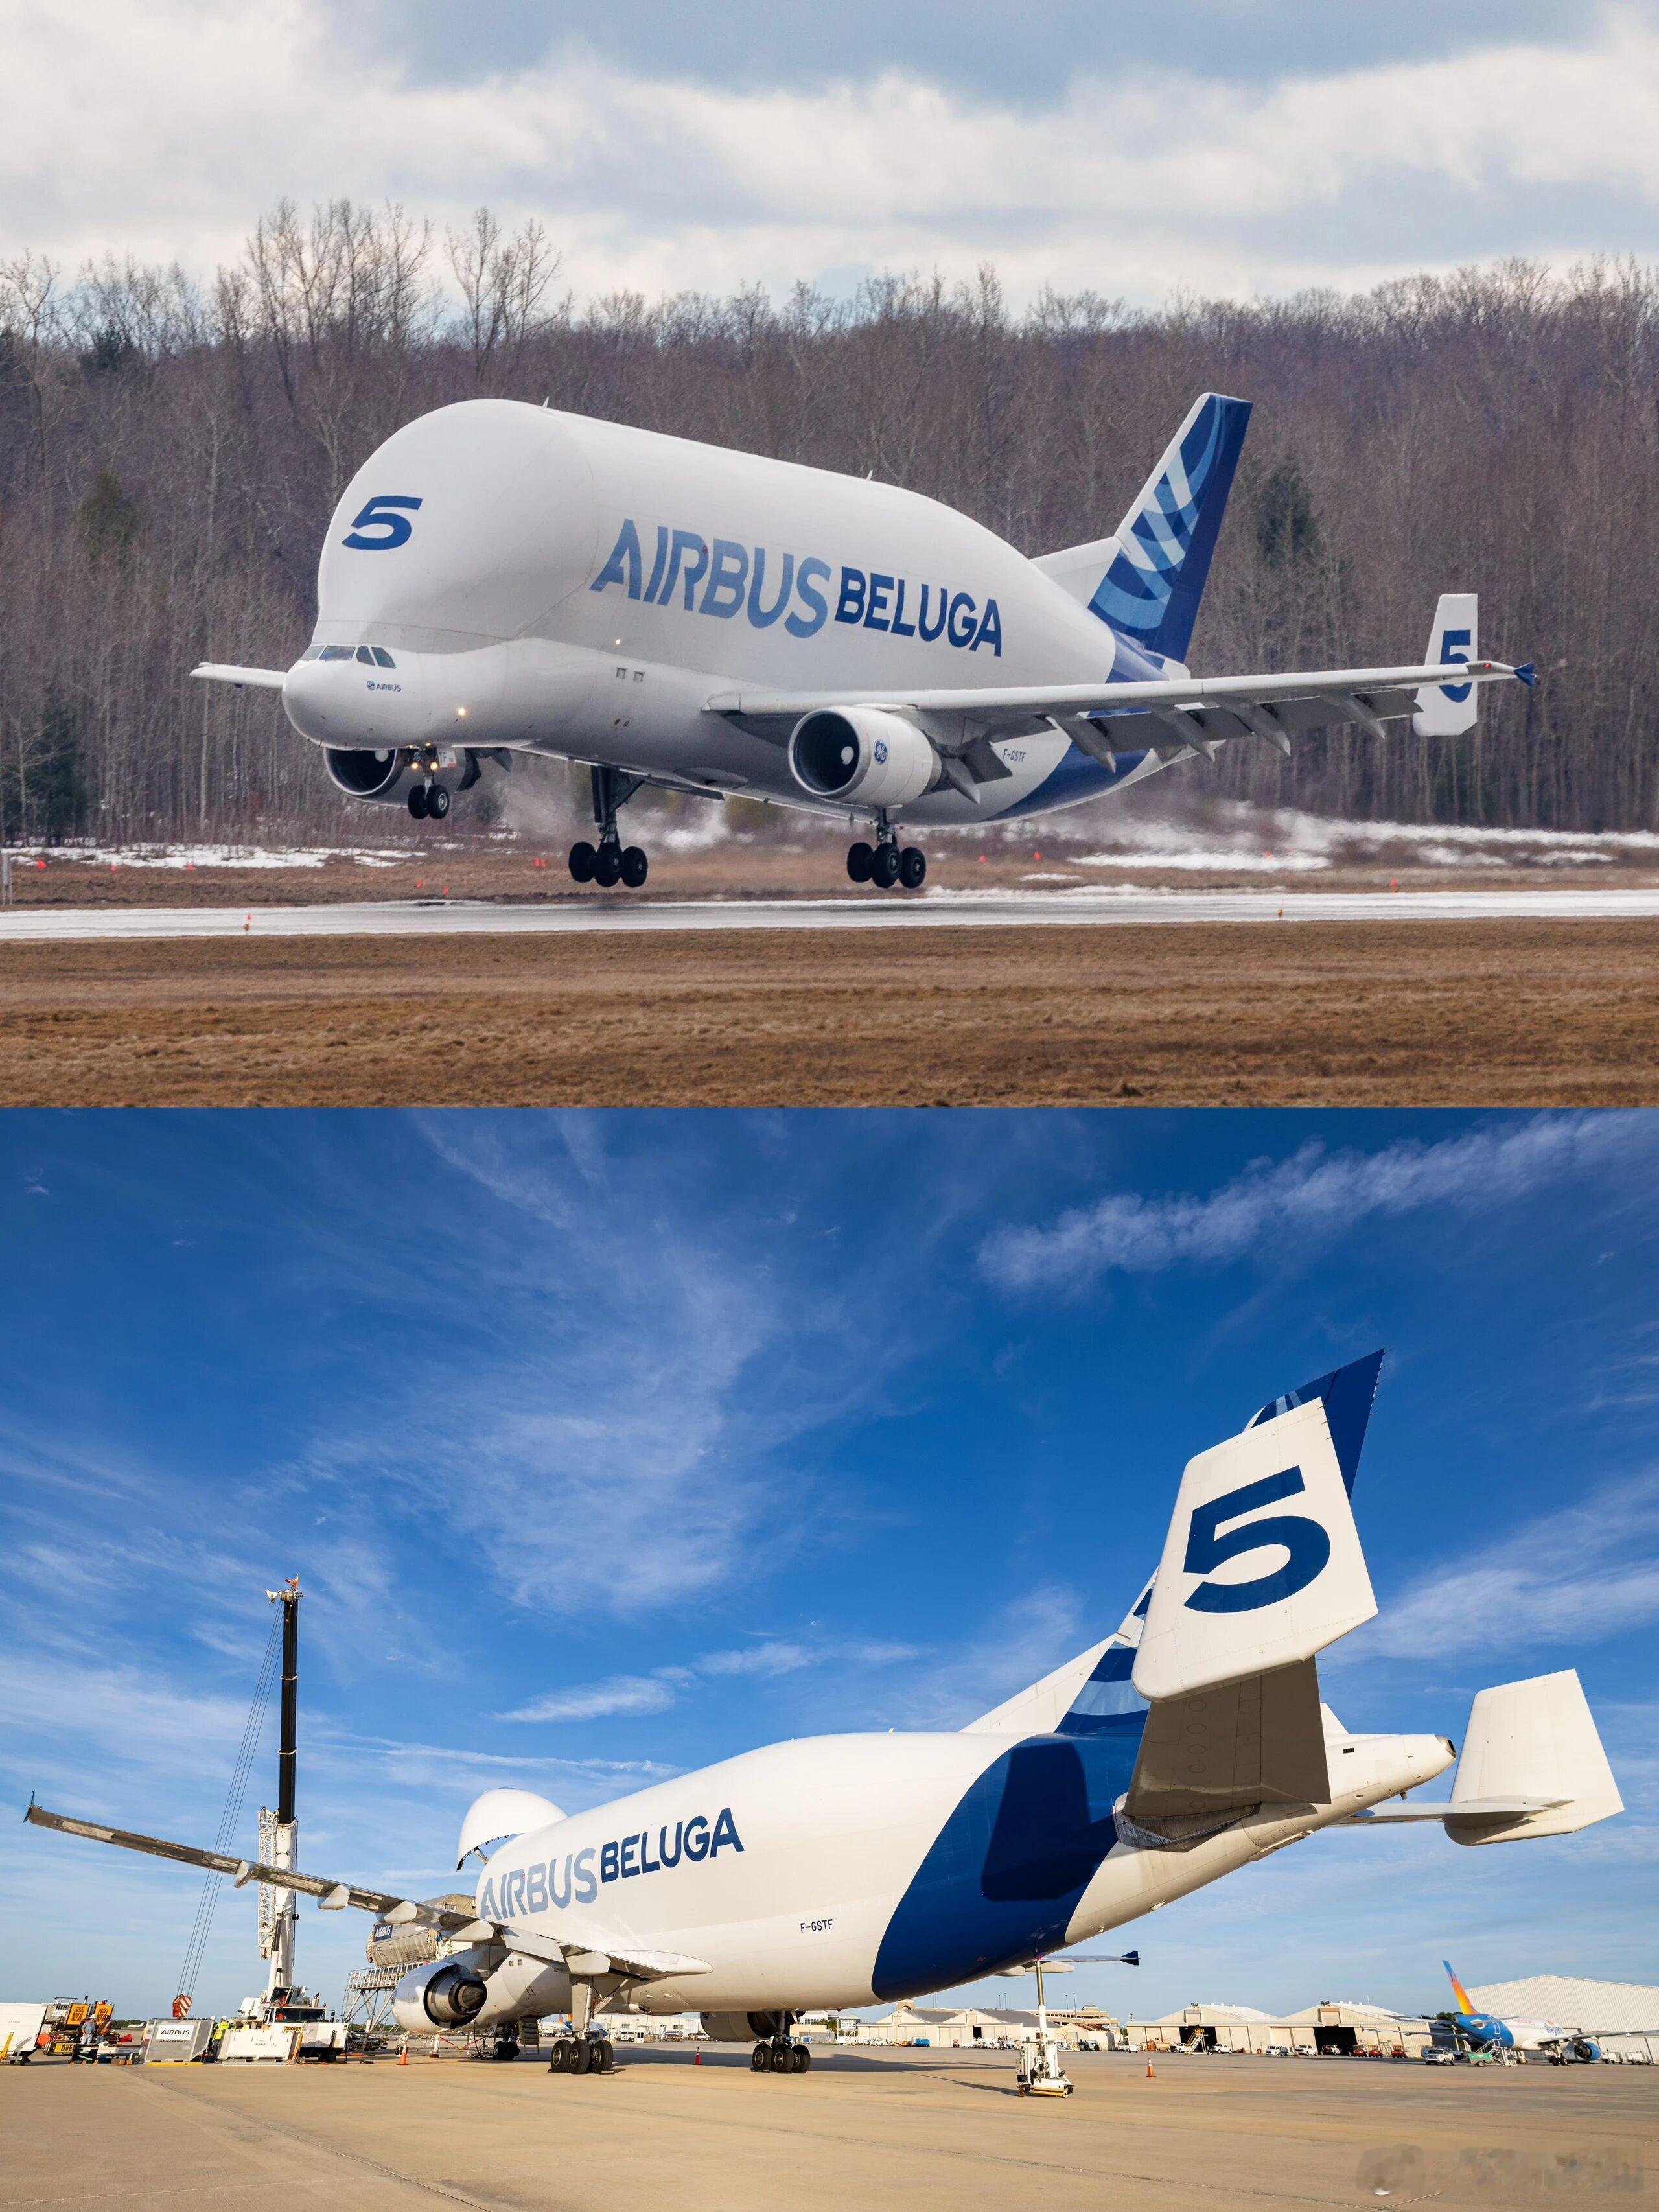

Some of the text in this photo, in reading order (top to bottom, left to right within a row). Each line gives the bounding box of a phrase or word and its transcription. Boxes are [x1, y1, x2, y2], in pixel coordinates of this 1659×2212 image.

[342, 496, 423, 550] 5
[590, 518, 1002, 657] AIRBUS BELUGA
[1439, 629, 1473, 703] 5
[1003, 749, 1027, 762] F-GSTF
[1183, 1465, 1330, 1613] 5
[480, 1808, 745, 1920] AIRBUS BELUGA
[375, 1925, 391, 1938] AIRBUS
[800, 1919, 833, 1933] F-GSTF
